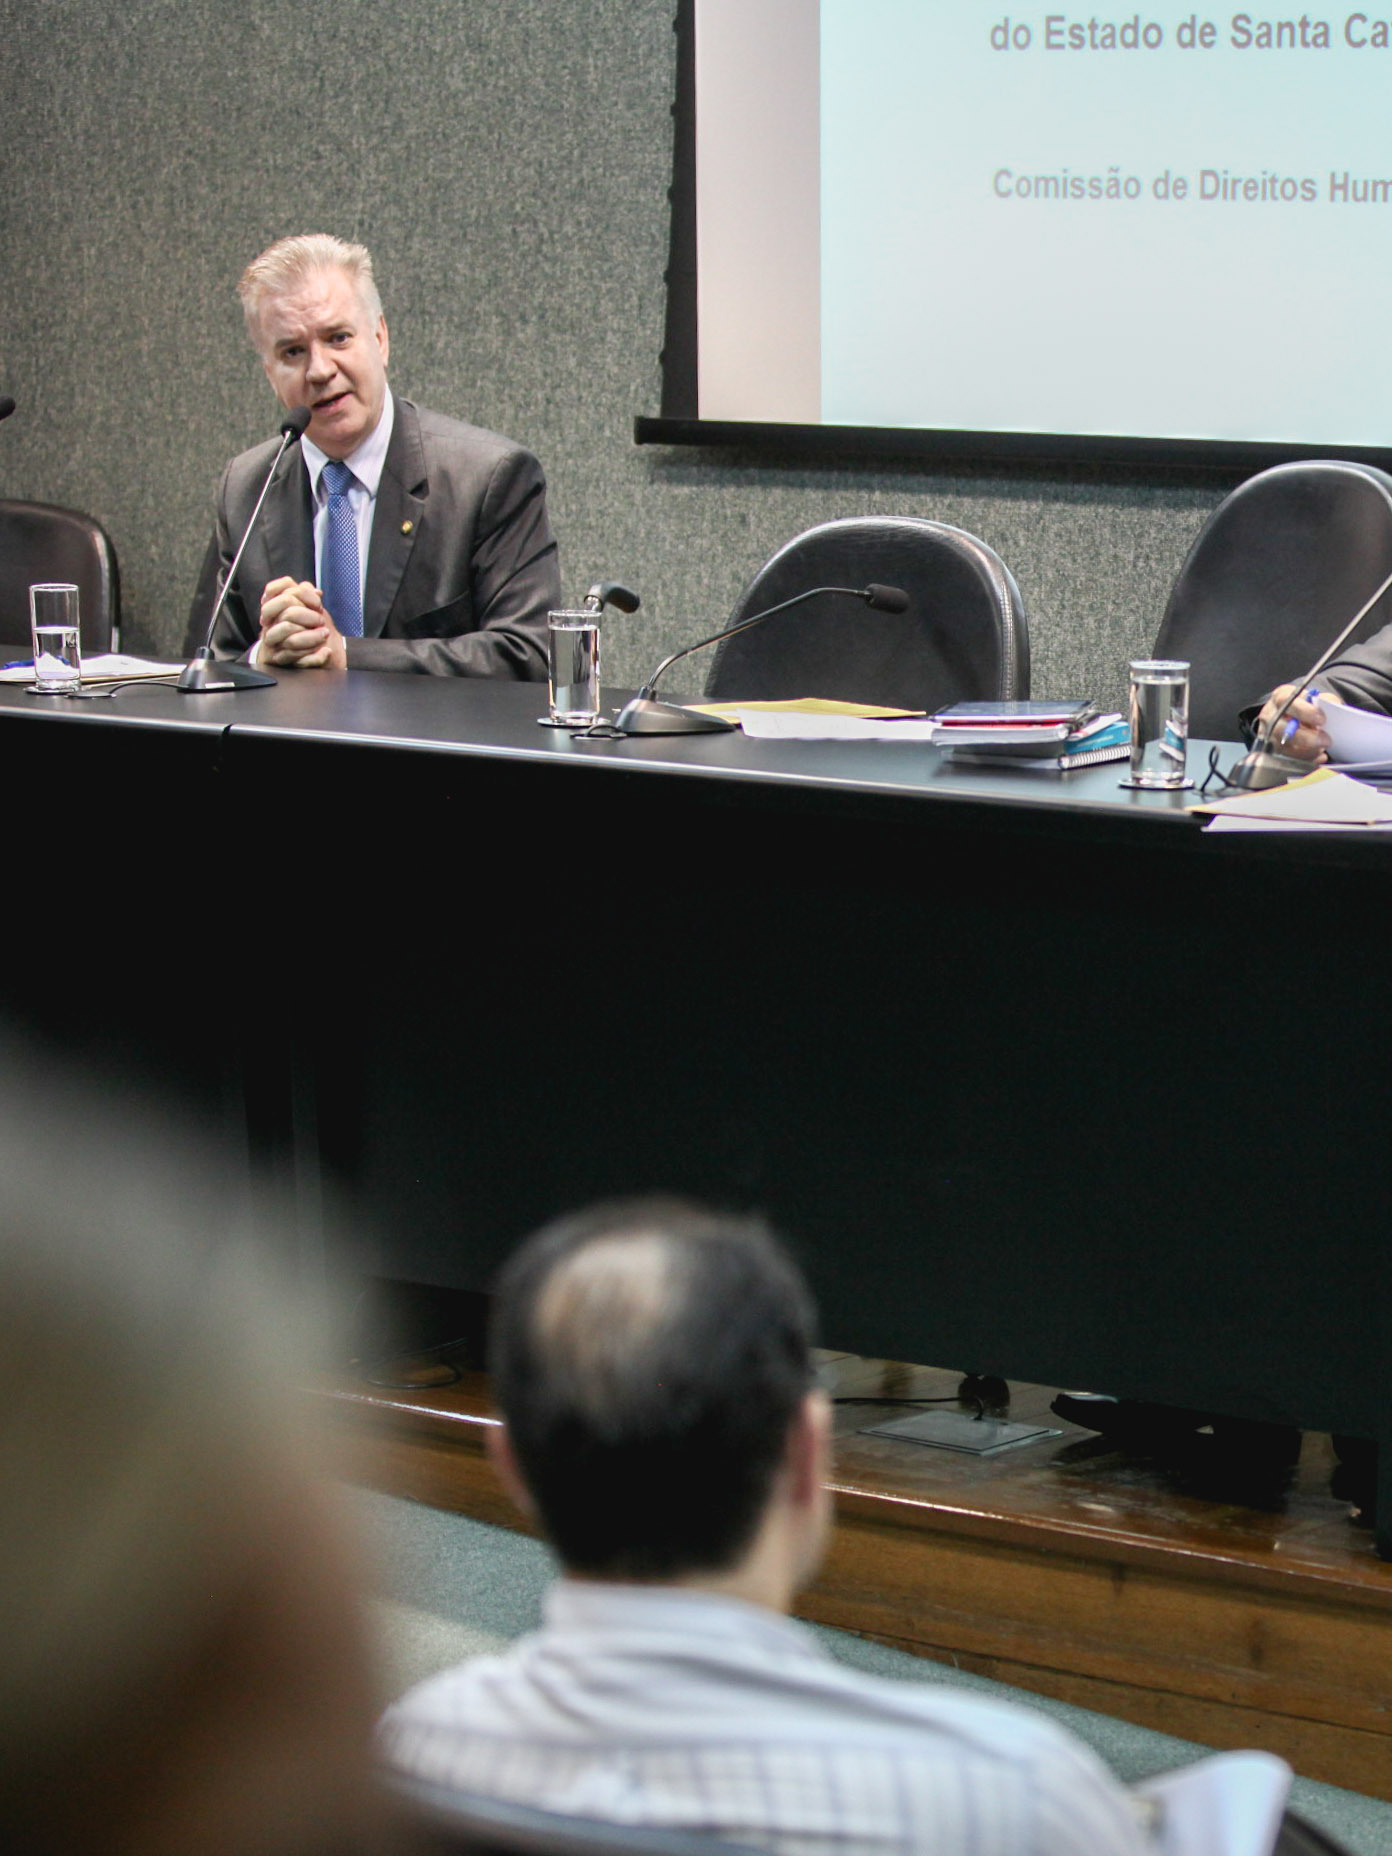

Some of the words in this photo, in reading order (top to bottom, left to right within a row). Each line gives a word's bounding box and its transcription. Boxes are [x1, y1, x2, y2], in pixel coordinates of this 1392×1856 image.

[989, 16, 1032, 51] do
[1043, 14, 1164, 51] Estado
[1175, 13, 1218, 50] de
[1229, 12, 1331, 50] Santa
[992, 166, 1142, 201] Comissão
[1151, 169, 1189, 201] de
[1198, 169, 1318, 202] Direitos
